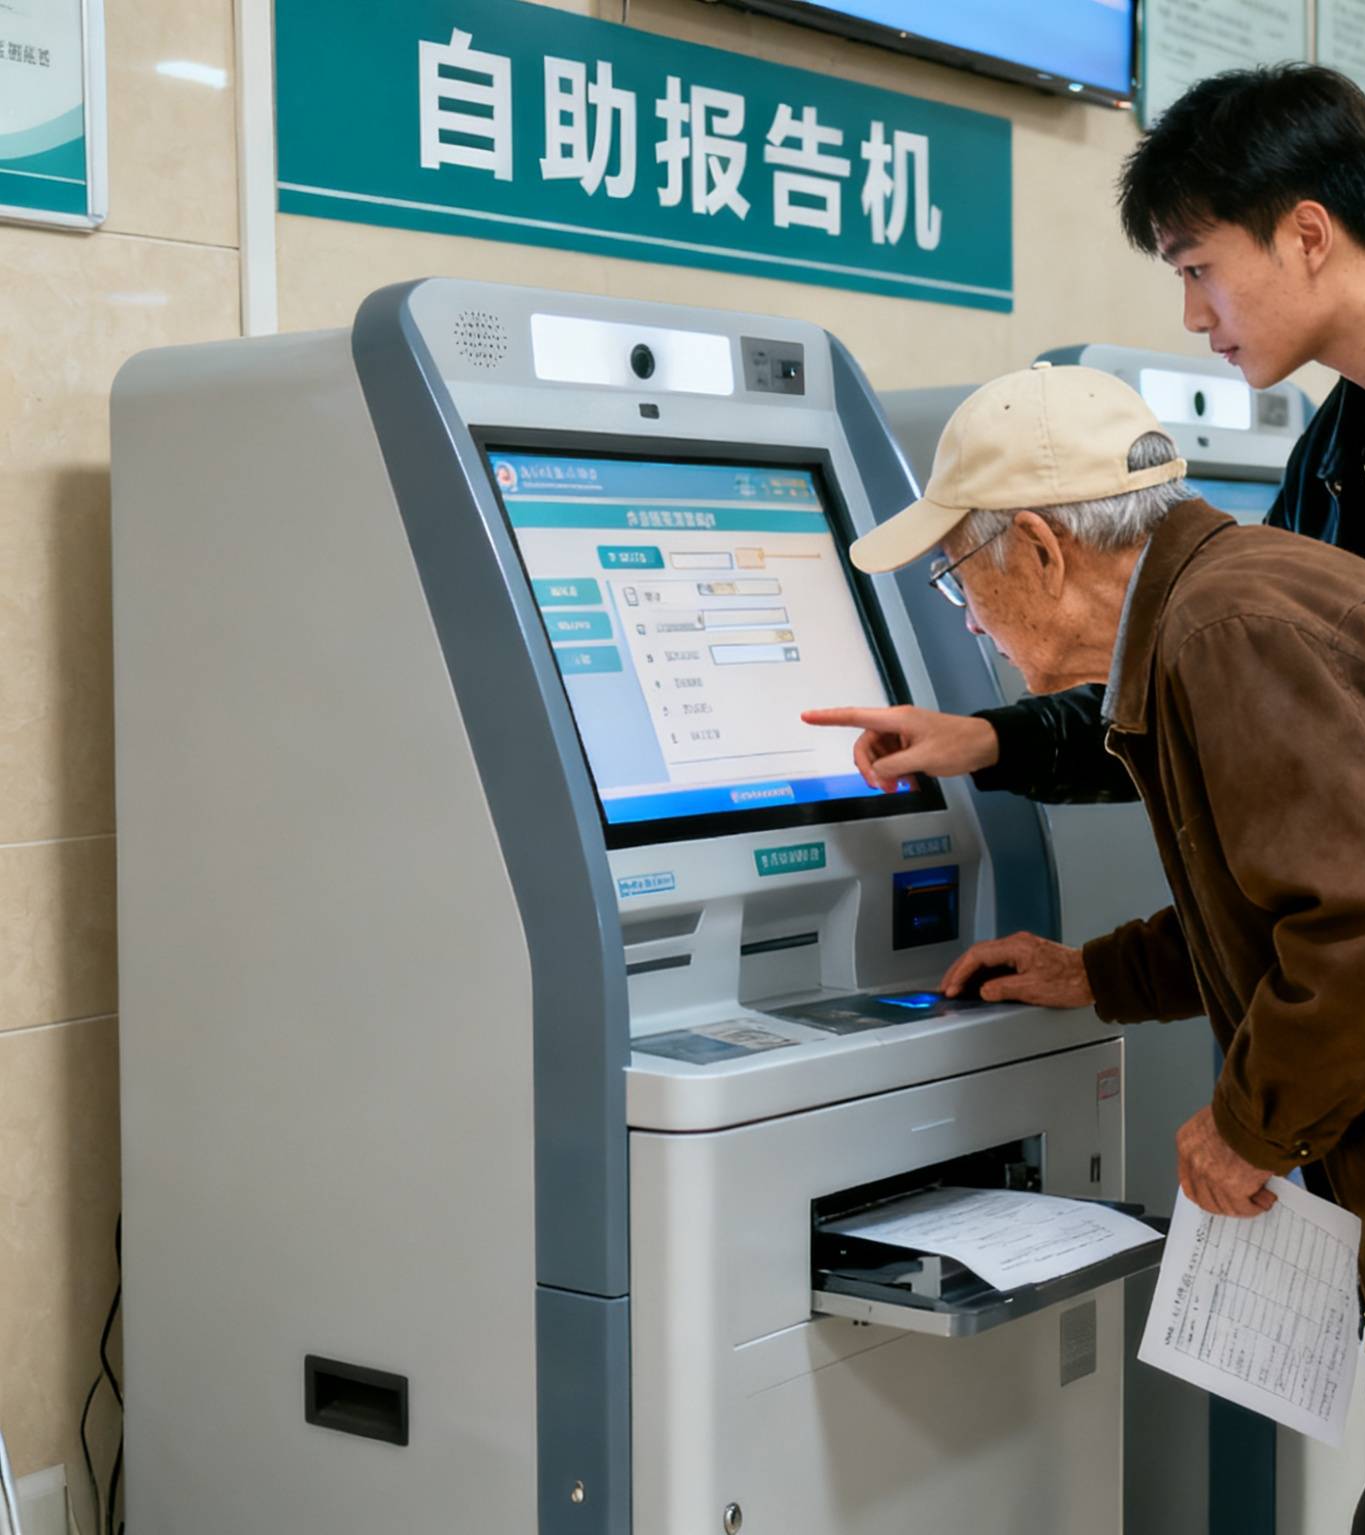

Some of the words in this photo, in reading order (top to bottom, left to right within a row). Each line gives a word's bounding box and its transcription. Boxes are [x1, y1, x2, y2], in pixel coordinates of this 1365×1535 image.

[419, 28, 942, 251] 自助报告机
